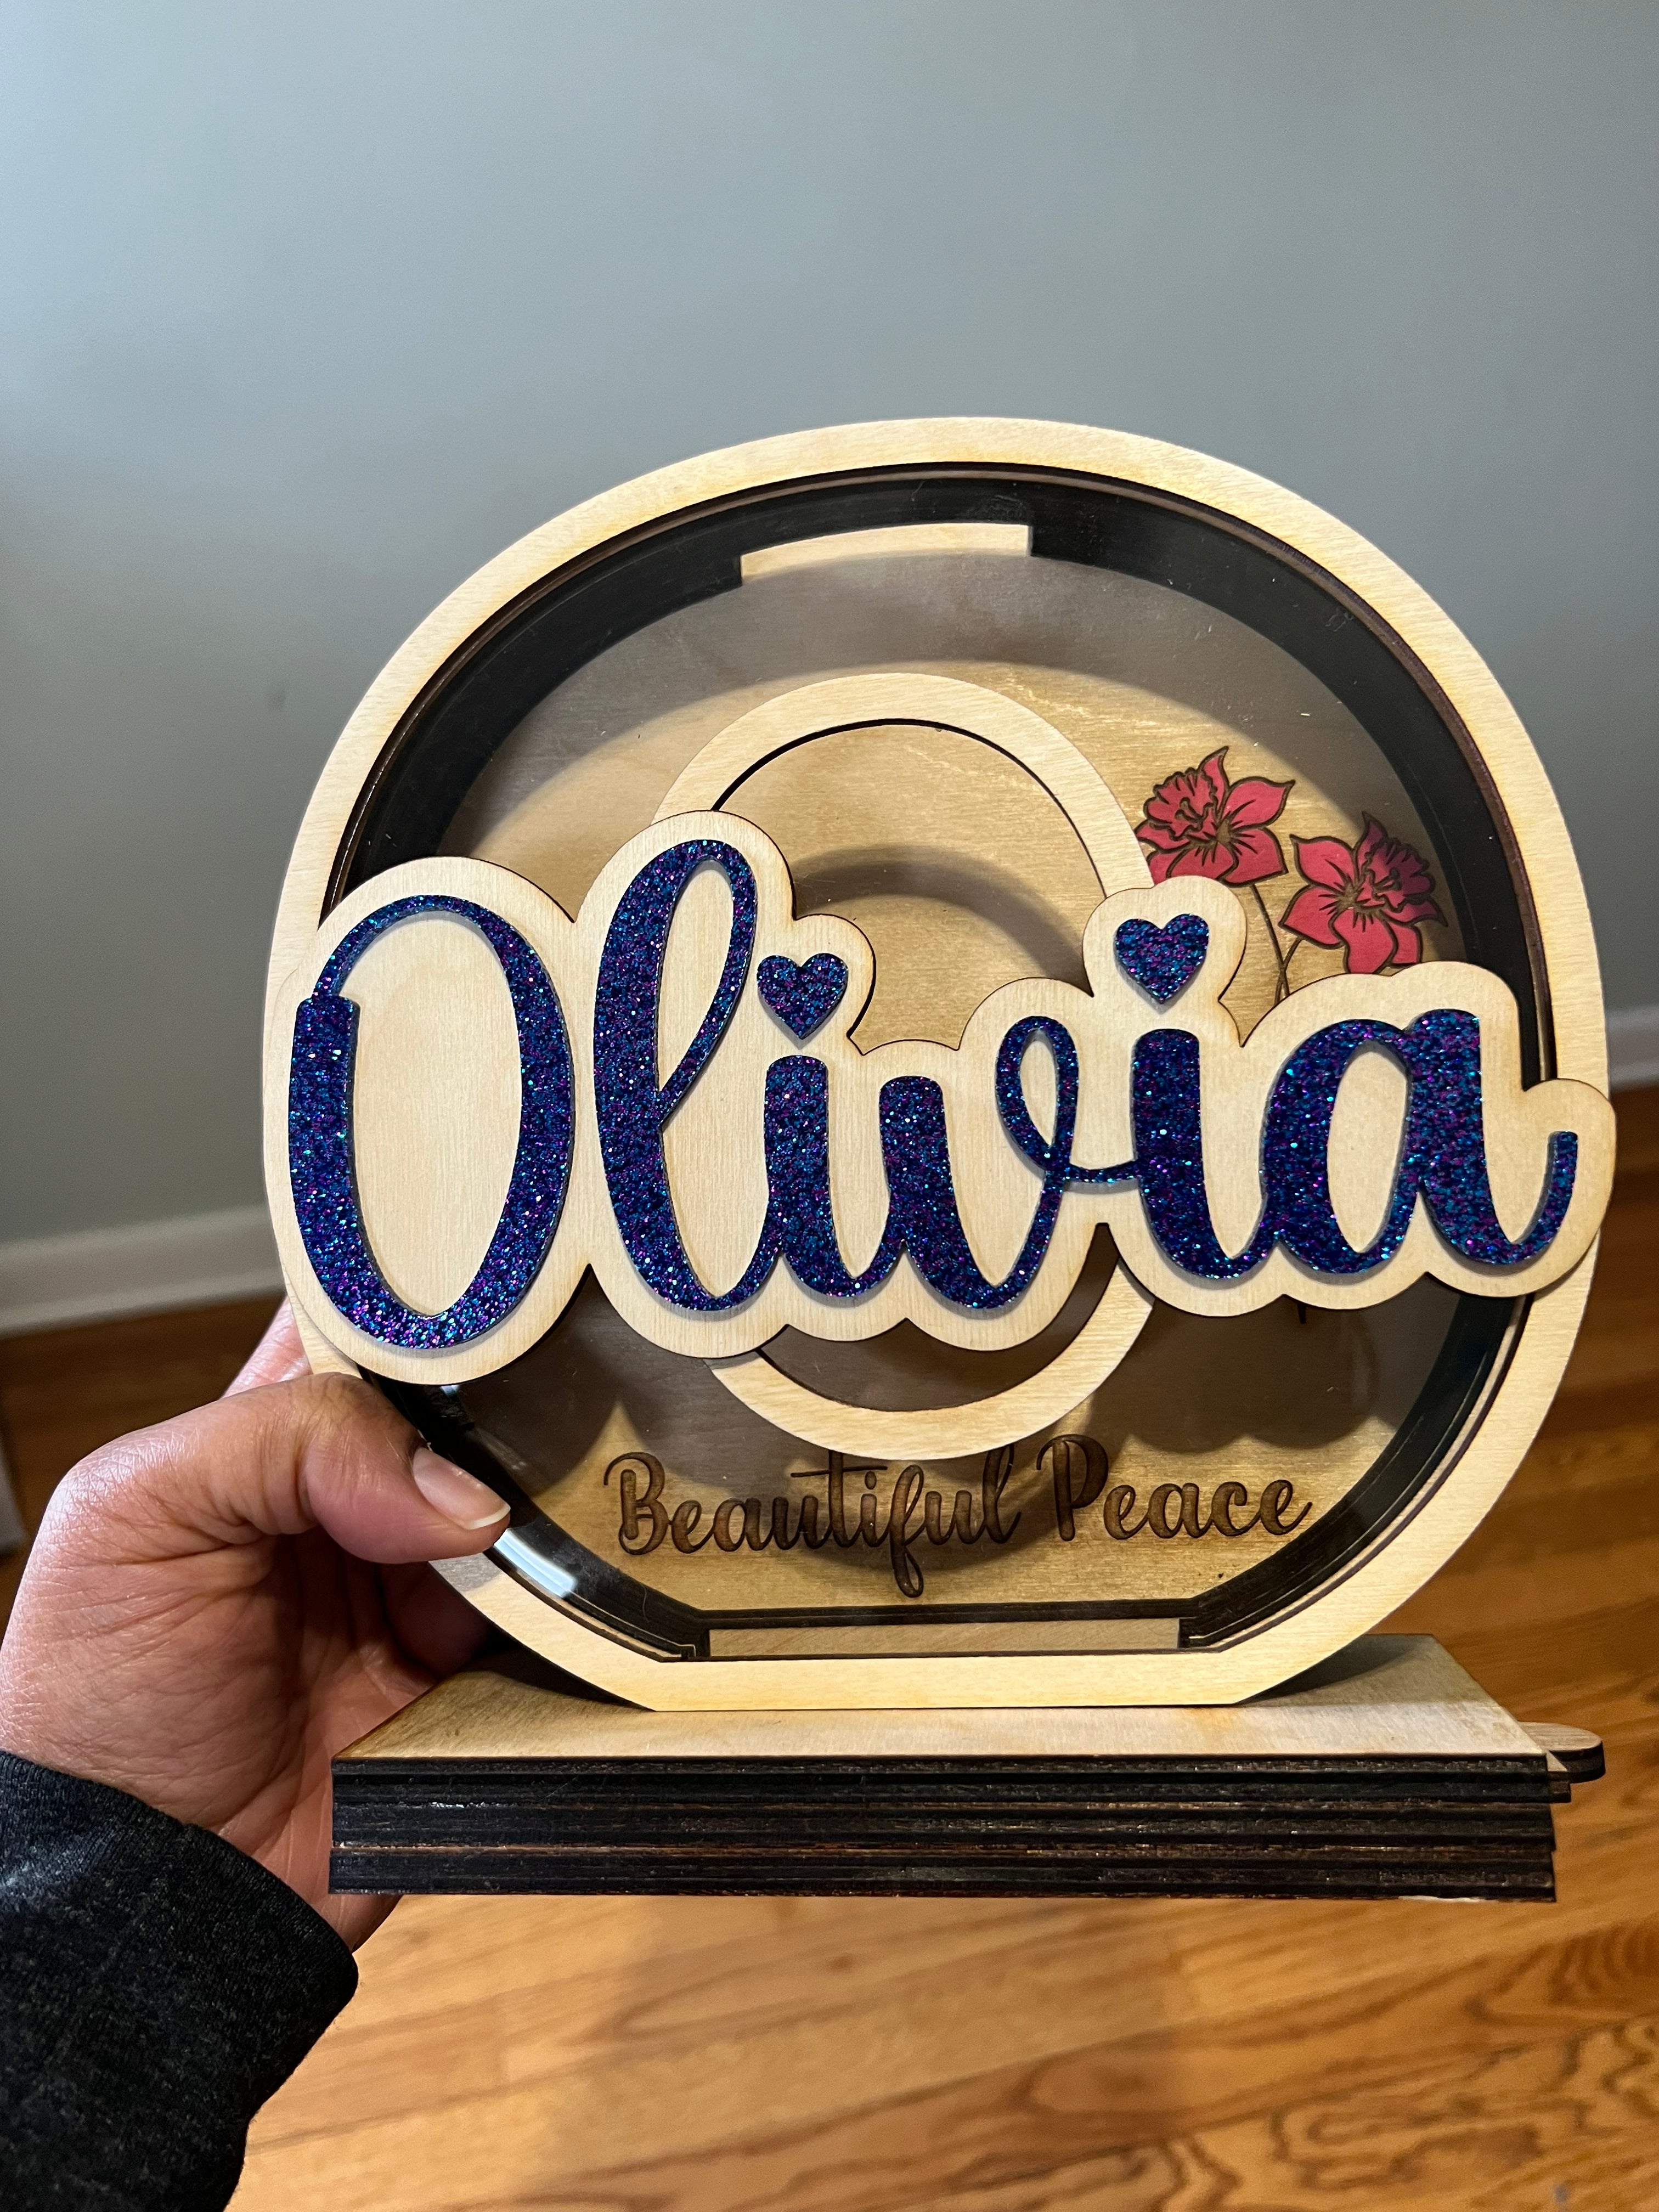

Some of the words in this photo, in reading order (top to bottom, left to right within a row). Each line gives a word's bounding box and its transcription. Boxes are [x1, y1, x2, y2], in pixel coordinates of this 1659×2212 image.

[288, 839, 1578, 1349] Olivia
[603, 1444, 1023, 1598] Beautiful
[1035, 1433, 1313, 1542] Peace
